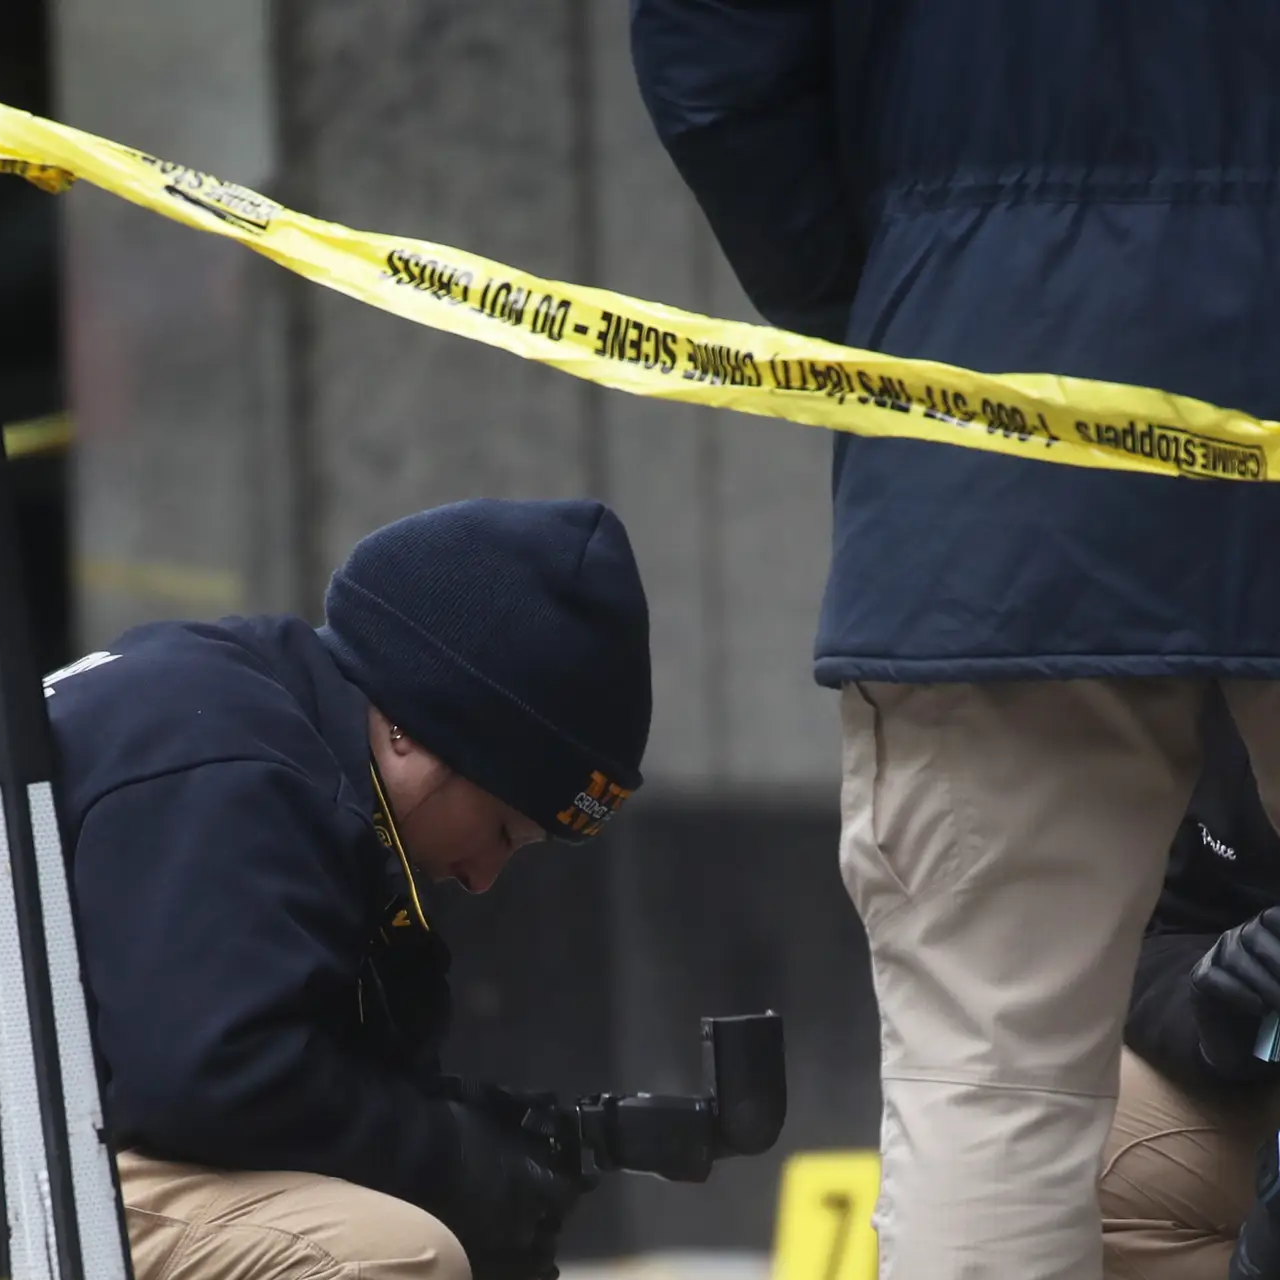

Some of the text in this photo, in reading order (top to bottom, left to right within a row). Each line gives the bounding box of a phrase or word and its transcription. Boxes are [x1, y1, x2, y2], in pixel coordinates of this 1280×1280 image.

[382, 249, 474, 308] CROSS
[472, 279, 532, 327] NOT
[531, 295, 572, 342] DO
[594, 311, 677, 374] SCENE
[683, 338, 762, 388] CRIME
